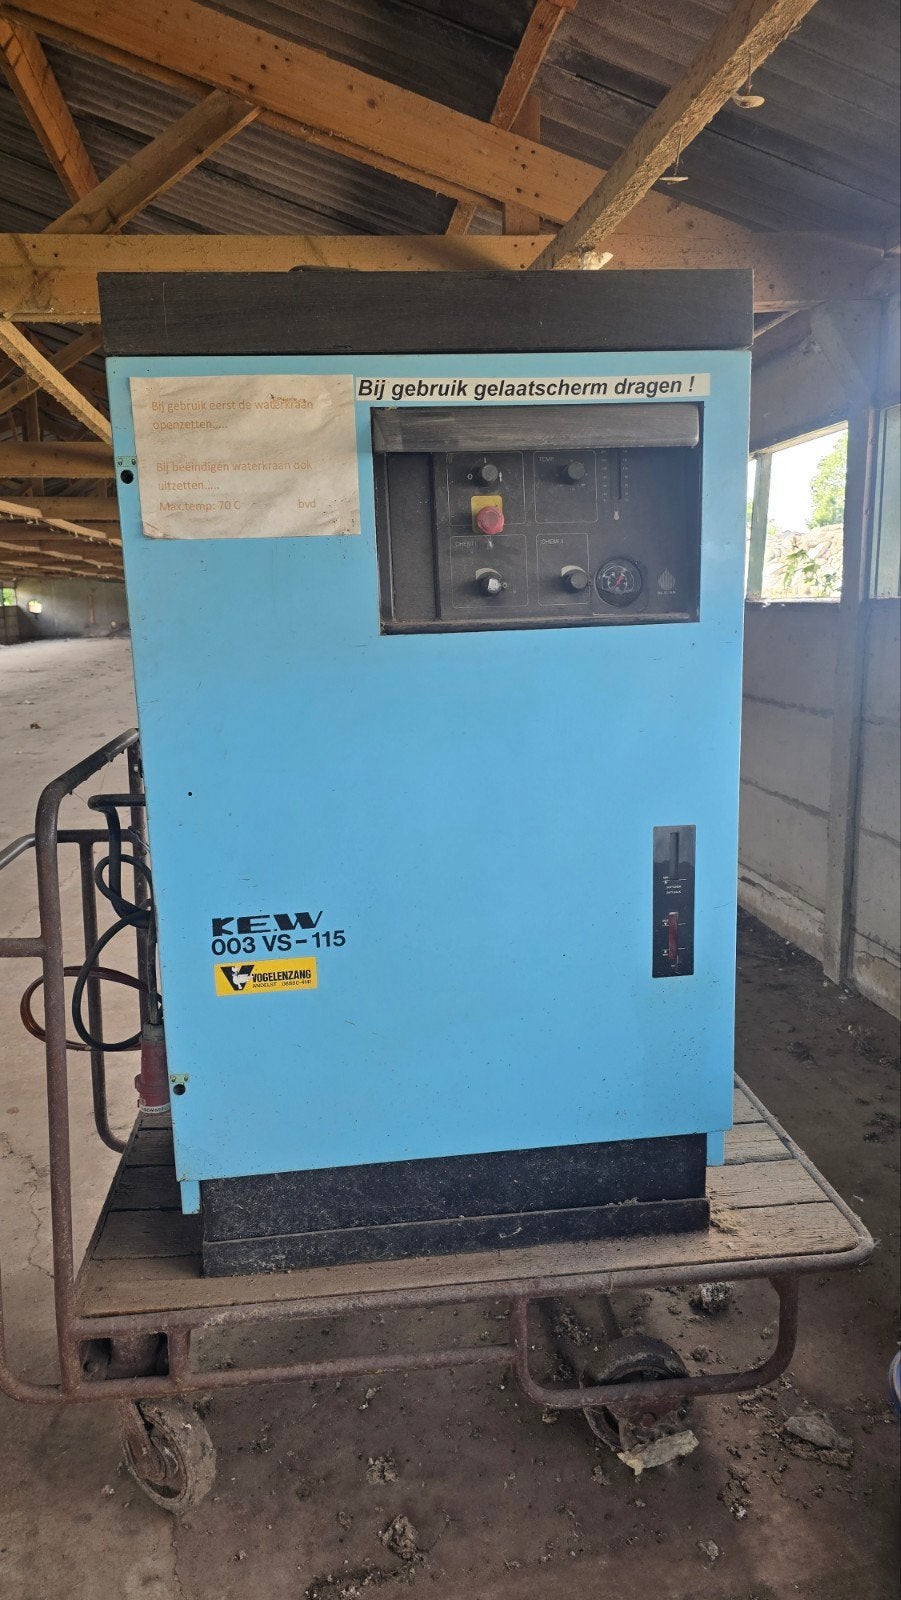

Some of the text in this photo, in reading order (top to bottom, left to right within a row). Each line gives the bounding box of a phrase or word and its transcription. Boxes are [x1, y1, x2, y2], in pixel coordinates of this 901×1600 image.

[358, 376, 695, 401] Bij gebruik gelaatscherm dragen !
[152, 399, 314, 414] Bij gebruik eerst de waterkraan
[156, 461, 170, 474] Bij
[232, 460, 291, 471] waterkraan
[294, 460, 313, 470] ook
[218, 501, 232, 510] 70
[233, 500, 240, 510] C
[298, 499, 316, 509] bvd
[212, 911, 323, 937] KEW
[211, 937, 256, 955] 003
[252, 970, 311, 982] VOGELENZANG
